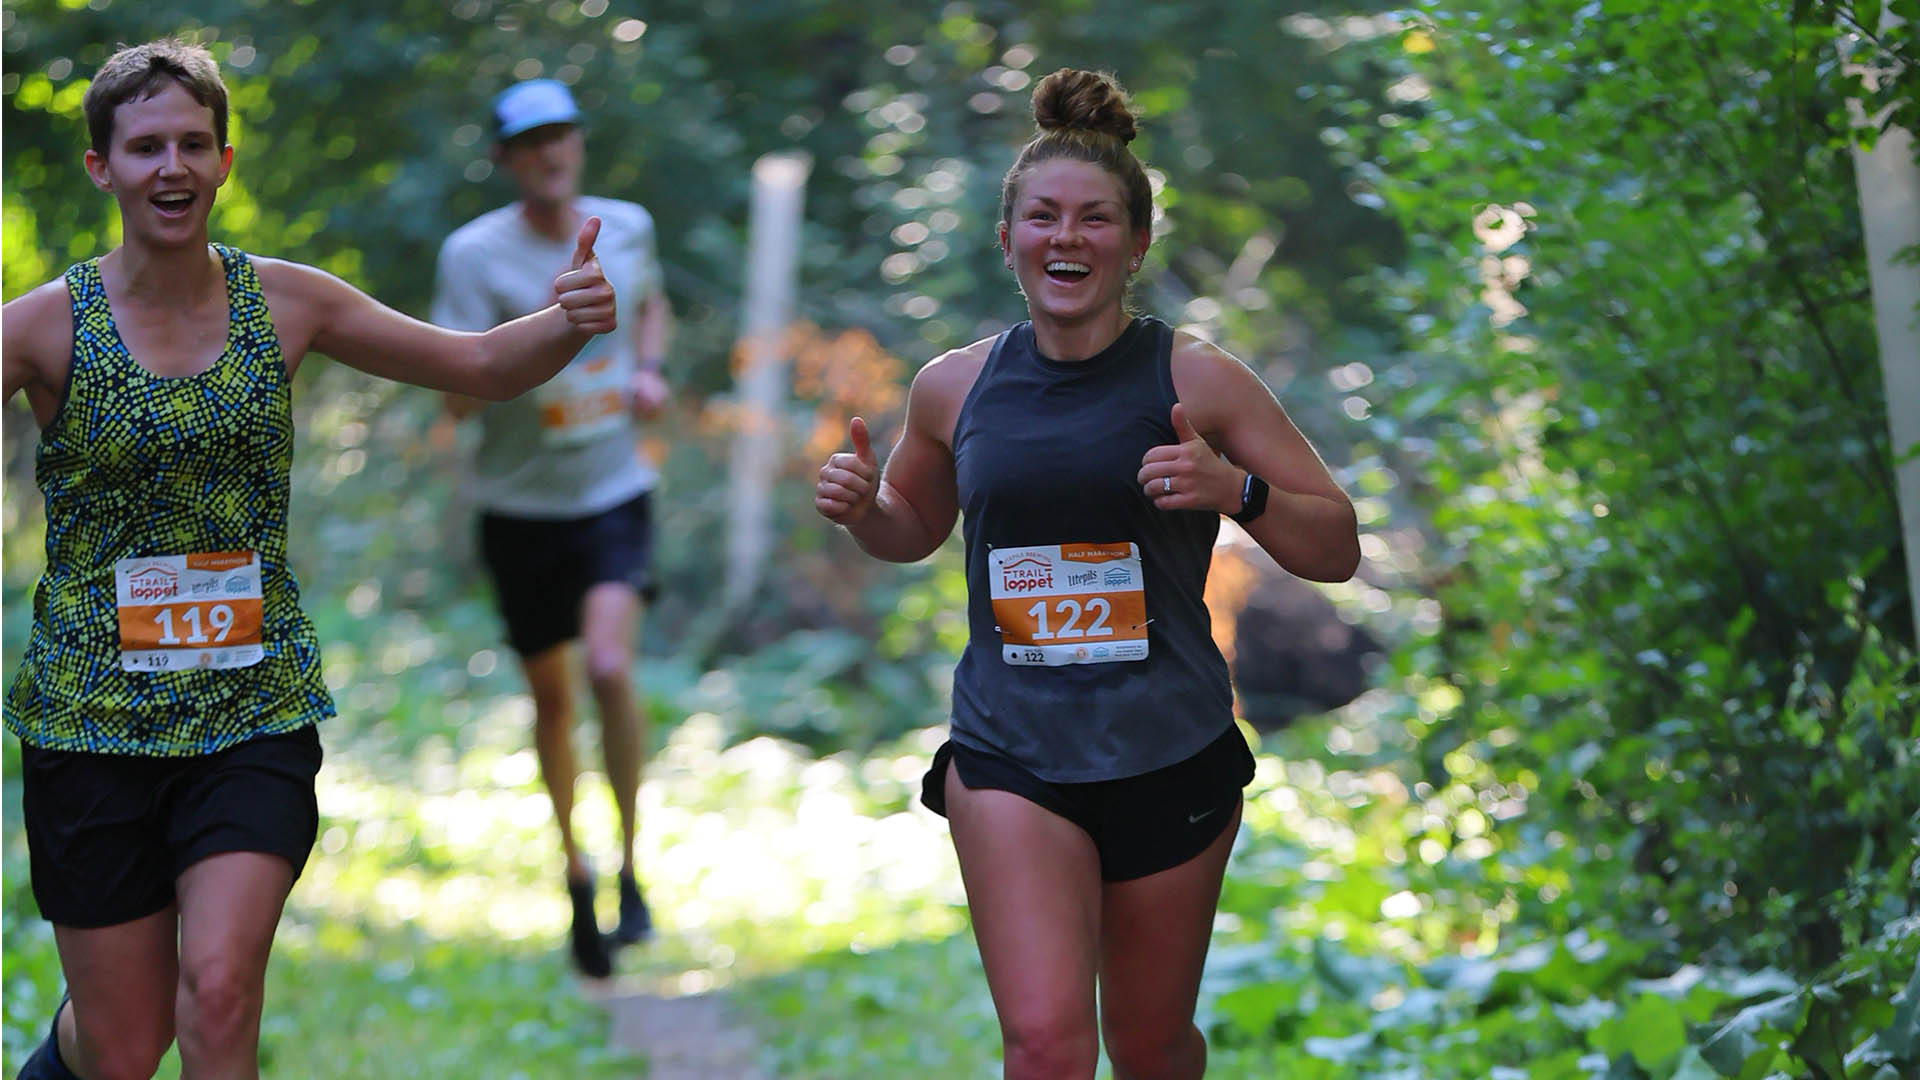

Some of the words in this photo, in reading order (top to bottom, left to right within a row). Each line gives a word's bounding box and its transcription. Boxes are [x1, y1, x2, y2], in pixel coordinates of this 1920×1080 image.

[139, 577, 170, 586] TRAIL
[1013, 569, 1044, 578] TRAIL
[1067, 569, 1098, 588] Utepils
[130, 582, 178, 600] loppet
[1004, 576, 1053, 592] loppet
[154, 604, 235, 645] 119
[1027, 597, 1113, 640] 122
[147, 655, 169, 667] 119
[1024, 652, 1045, 663] 122
